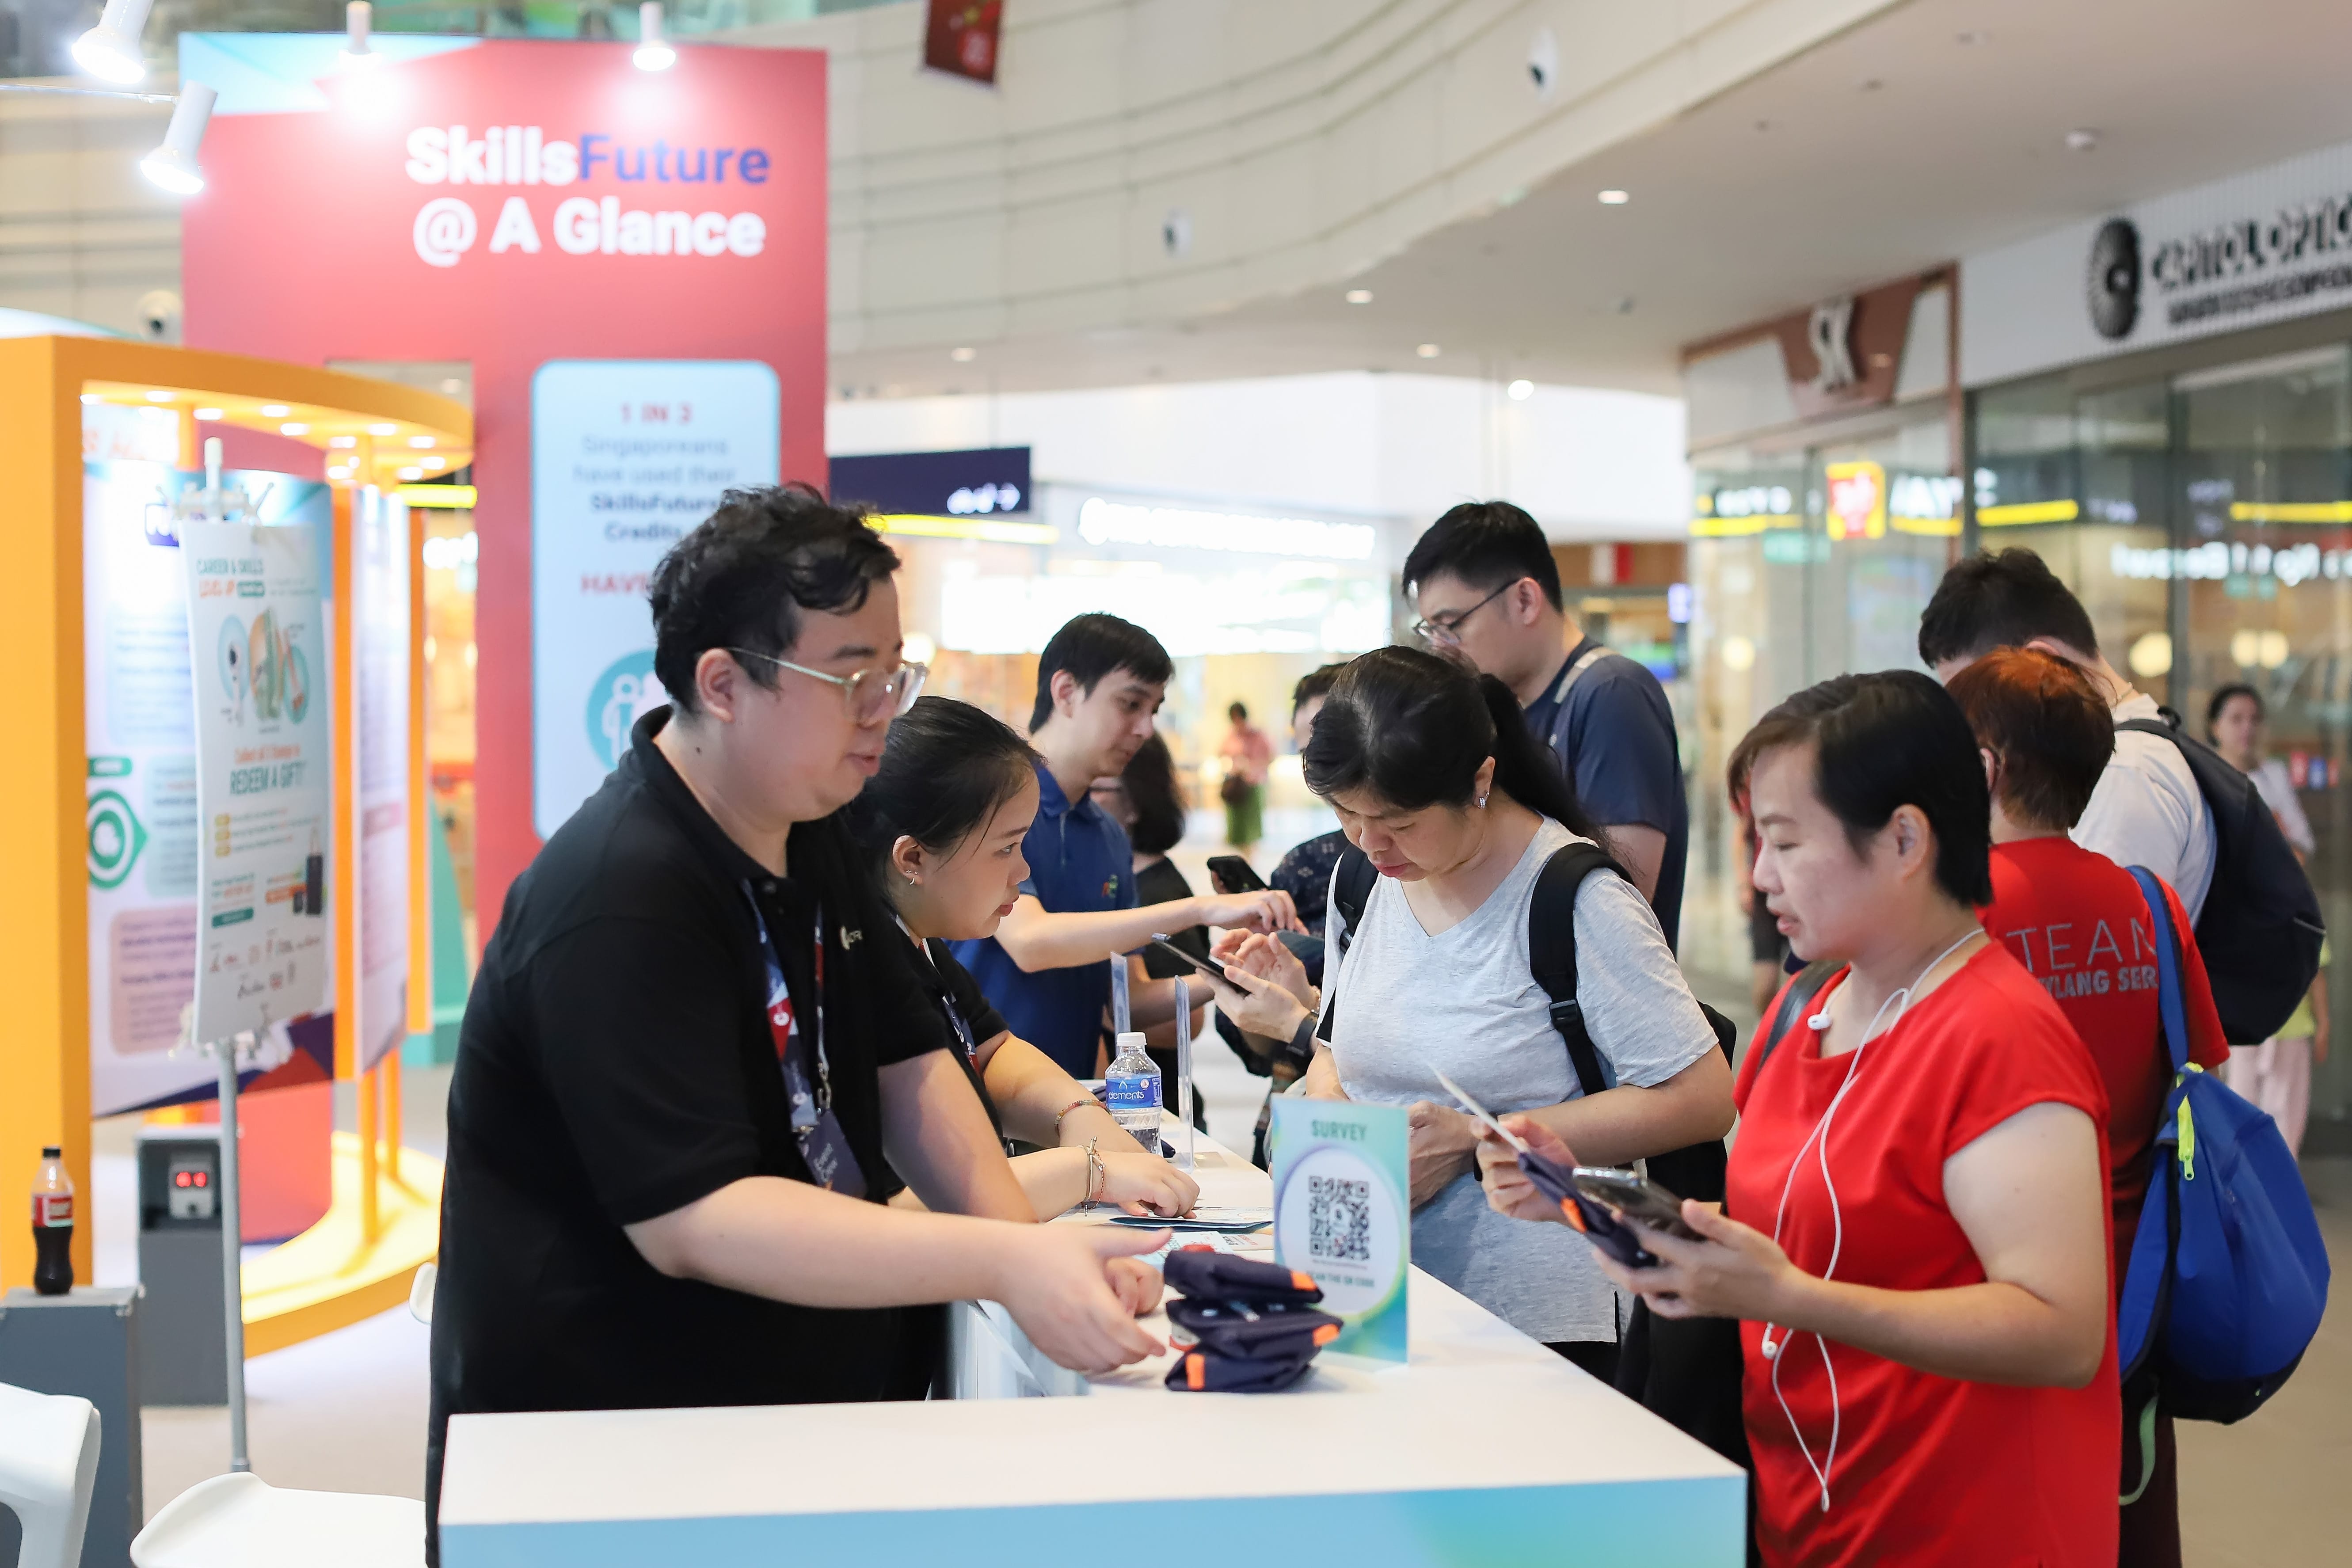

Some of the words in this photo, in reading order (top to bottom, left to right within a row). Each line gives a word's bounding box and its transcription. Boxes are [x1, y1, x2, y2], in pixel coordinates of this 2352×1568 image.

[404, 125, 770, 186] SkillsFuture
[413, 197, 478, 268] @
[488, 196, 541, 254] A
[553, 195, 766, 257] Glance
[1108, 1090, 1145, 1100] elements
[1311, 1119, 1368, 1143] SURVEY
